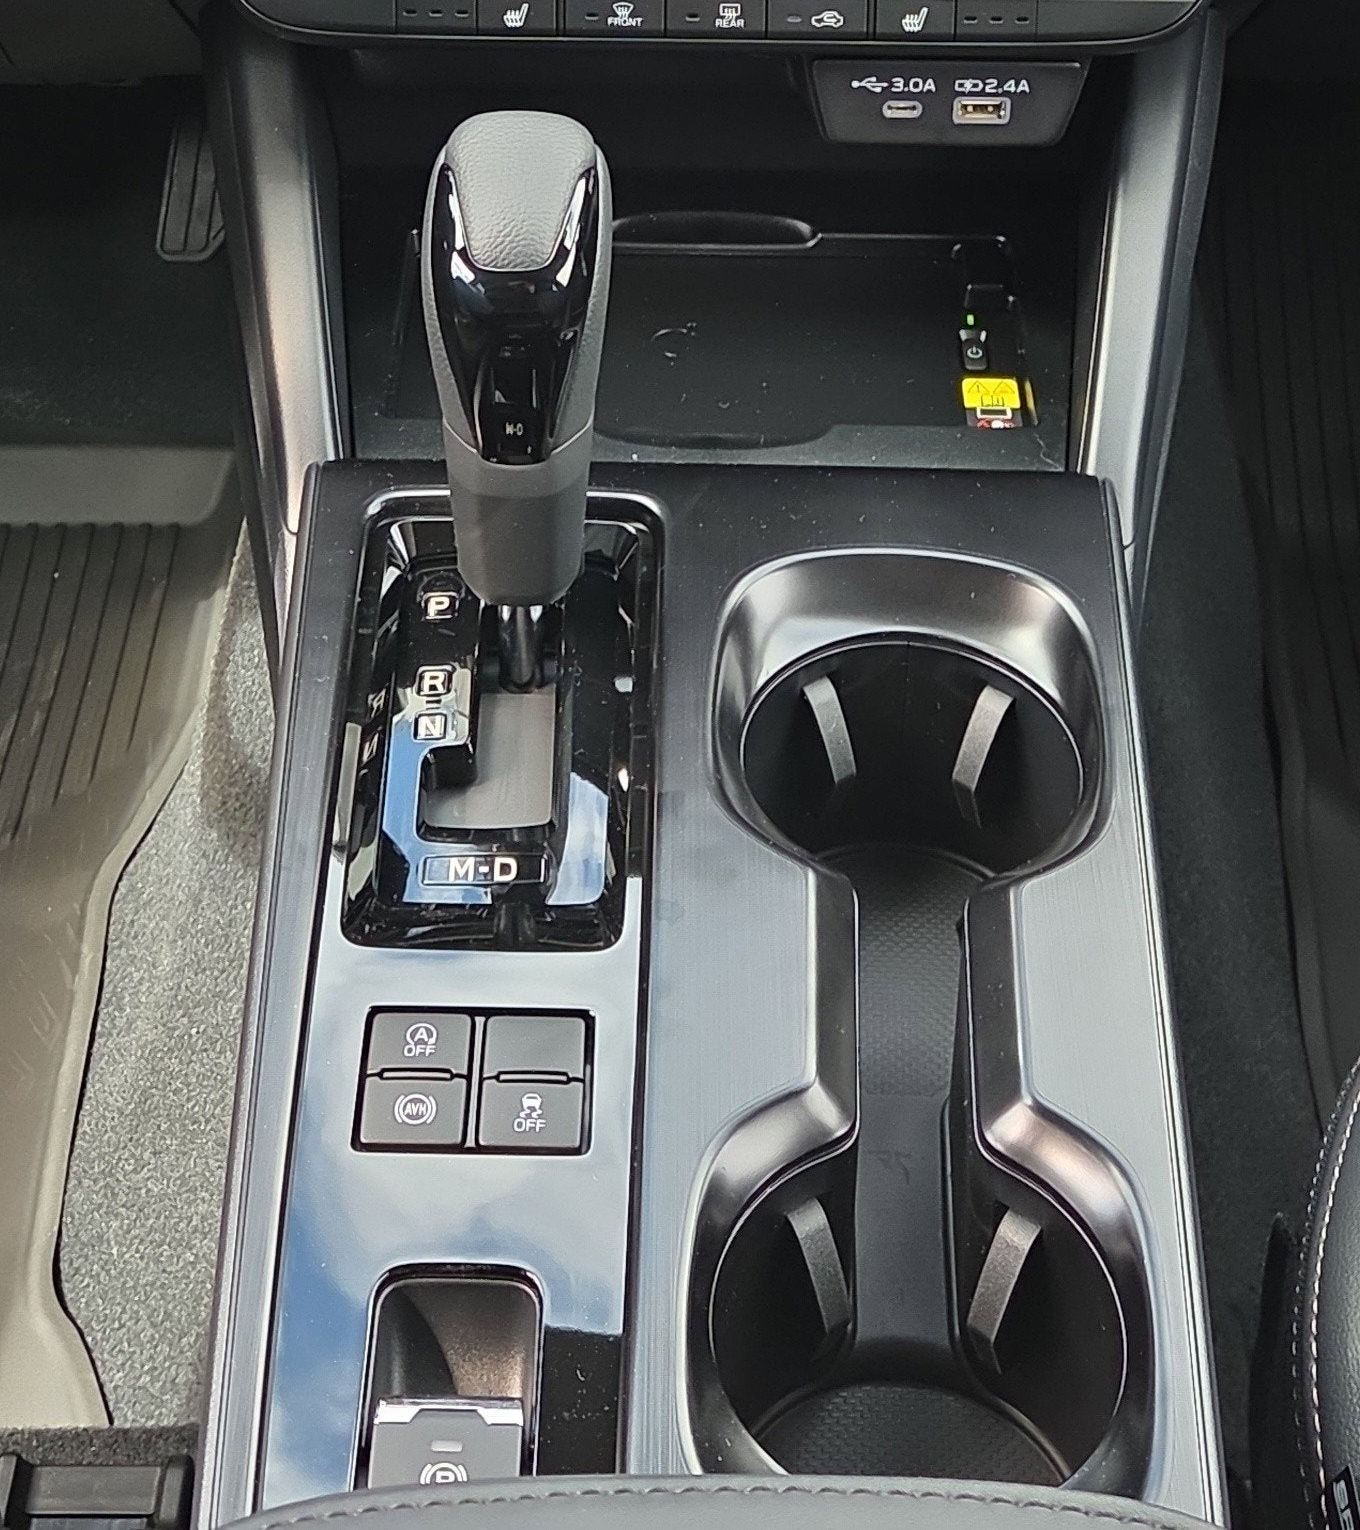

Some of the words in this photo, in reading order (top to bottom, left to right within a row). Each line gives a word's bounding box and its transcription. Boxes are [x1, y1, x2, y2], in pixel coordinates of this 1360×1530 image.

[607, 17, 643, 28] FRONT
[715, 18, 745, 29] REAR
[891, 77, 937, 93] 3.0A
[984, 78, 1031, 95] 2.4A
[428, 596, 451, 611] P
[424, 671, 445, 692] R
[417, 716, 443, 739] N
[403, 1045, 436, 1057] OFF
[404, 1102, 428, 1116] AVH
[513, 1118, 546, 1132] OFF
